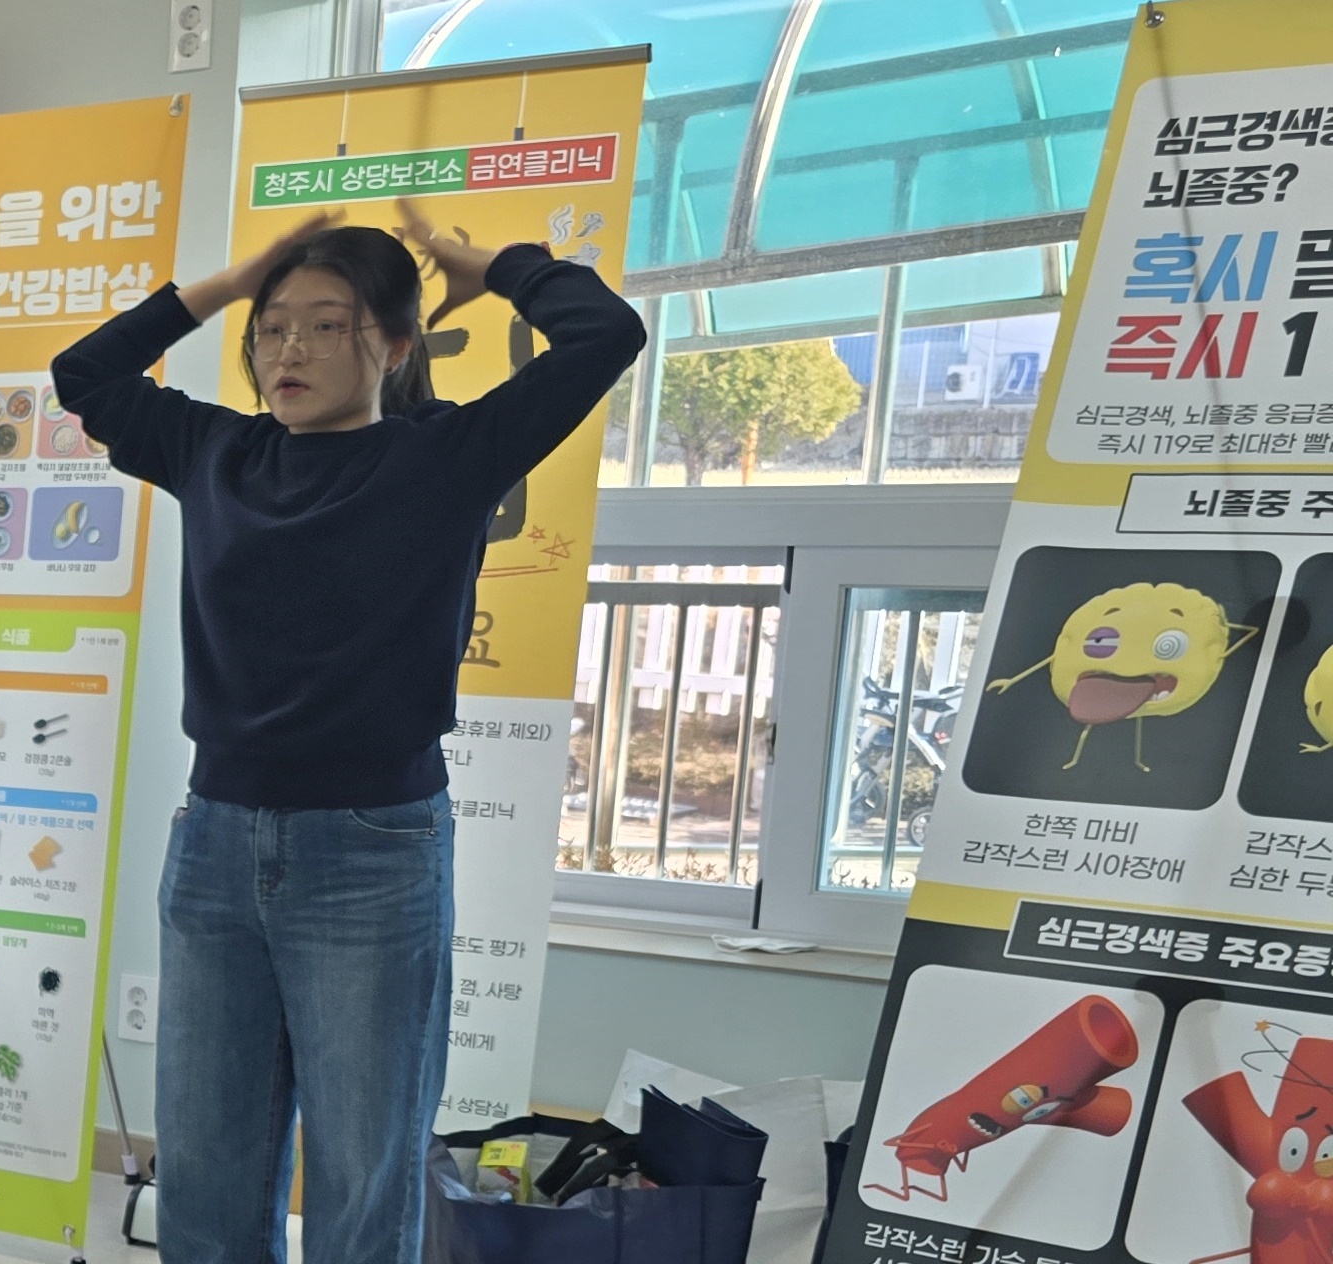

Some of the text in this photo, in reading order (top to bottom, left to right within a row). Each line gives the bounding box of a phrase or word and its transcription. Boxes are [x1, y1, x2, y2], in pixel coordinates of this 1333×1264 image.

[264, 144, 603, 198] 청주시 상당보건소 금연클리닉
[1143, 163, 1299, 208] 뇌졸중?
[56, 181, 162, 242] 위한
[1123, 231, 1279, 304] 혹시
[1105, 311, 1259, 380] 즉시
[1076, 404, 1176, 427] 심근경색,
[1183, 403, 1258, 425] 뇌졸중
[1098, 433, 1333, 455] 즉시 119로 최대한 빨
[1183, 489, 1291, 518] 뇌졸중
[1, 629, 31, 646] 식품
[508, 721, 552, 741] 제외)
[1024, 812, 1139, 846] 한쪽 마비
[962, 840, 1187, 885] 갑작스런 시야장애
[1245, 830, 1333, 862] 갑작스
[1229, 864, 1333, 898] 심한 두
[489, 938, 525, 958] 평가
[1036, 915, 1333, 978] 심근경색증 주요증
[460, 978, 522, 1001] 껌, 사탕
[457, 1096, 509, 1119] 상담실
